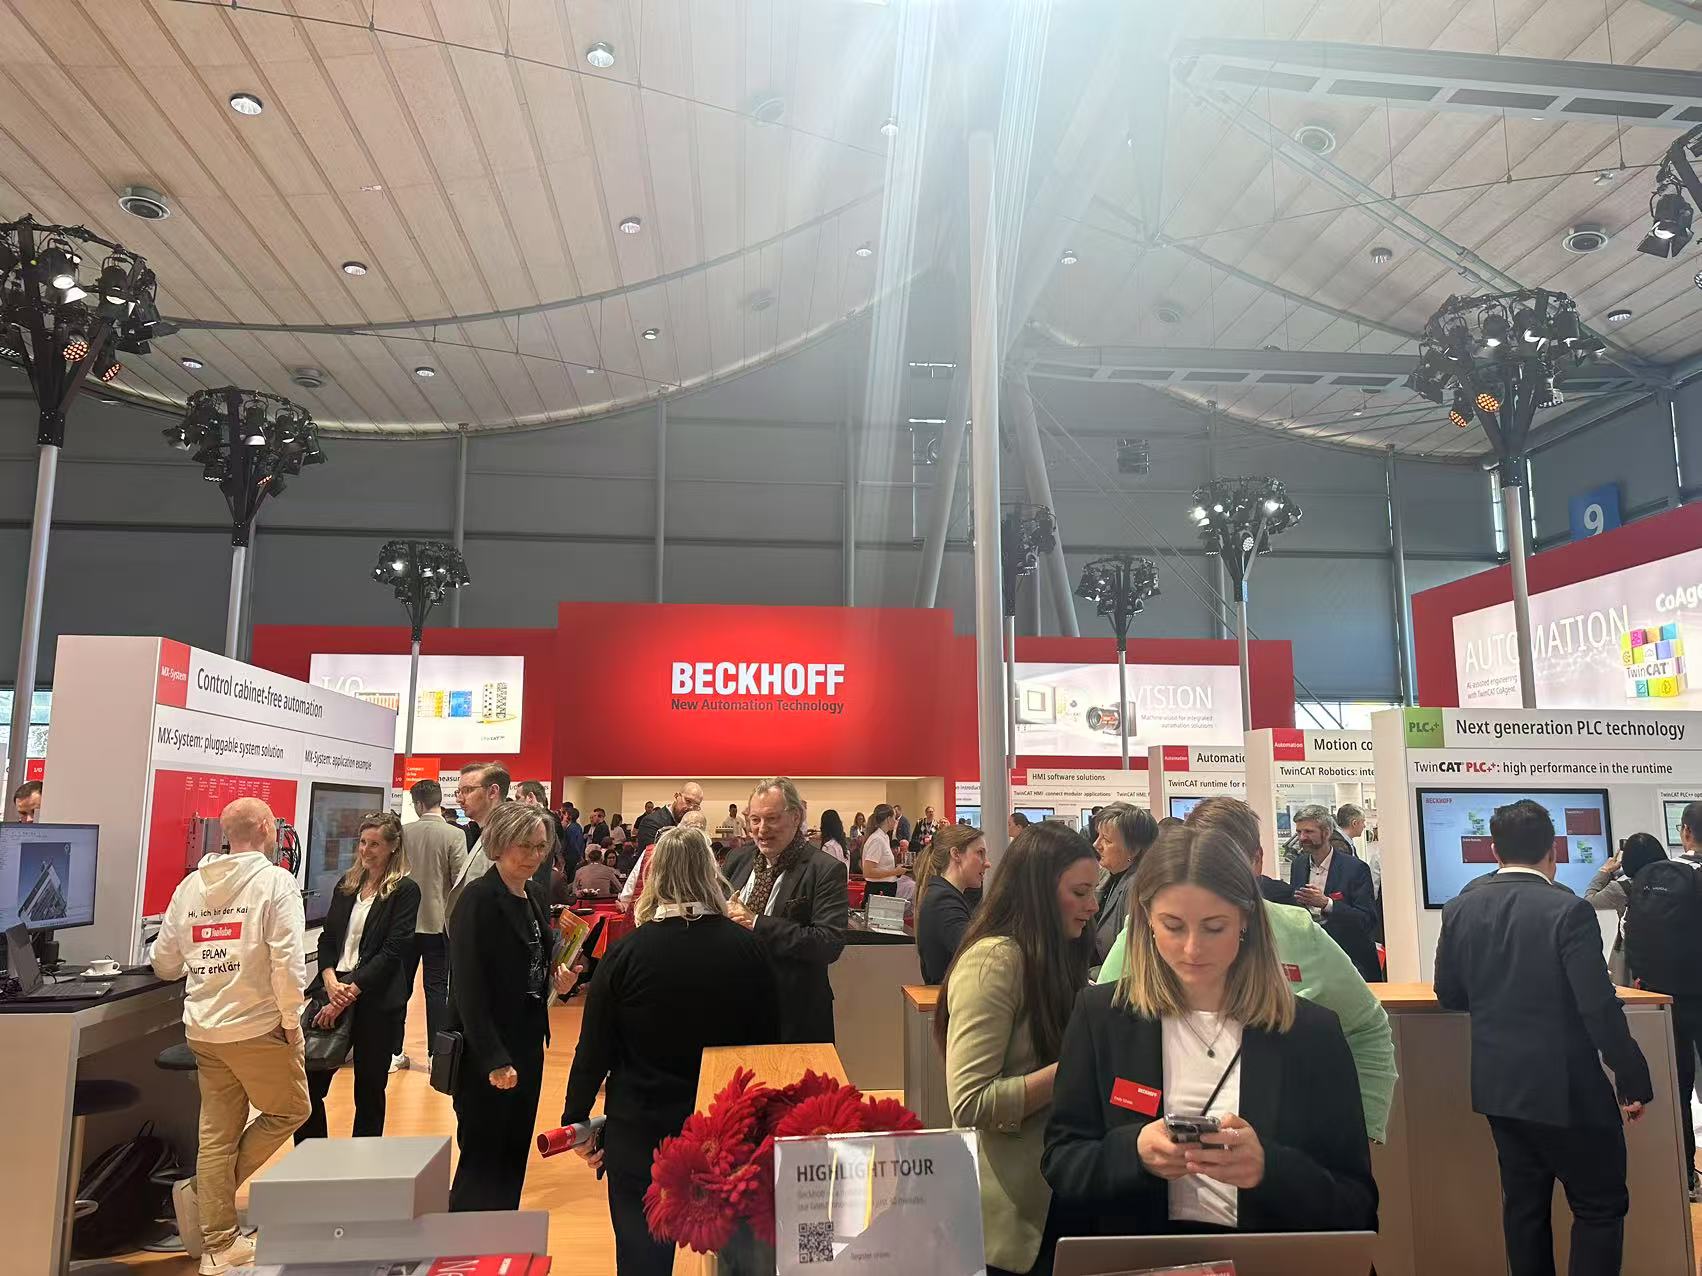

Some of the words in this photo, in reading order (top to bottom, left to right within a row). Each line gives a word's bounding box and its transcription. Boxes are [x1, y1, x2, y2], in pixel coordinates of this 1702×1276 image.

[1583, 503, 1604, 537] 9
[161, 665, 187, 681] MX-System
[1627, 661, 1668, 679] TwinCAT
[672, 661, 845, 696] BECKHOFF
[197, 667, 232, 697] Control
[234, 678, 283, 709] cabinet-free
[284, 694, 323, 718] automation
[1128, 685, 1213, 709] VISION
[672, 699, 698, 710] New
[701, 699, 773, 711] Automation
[777, 699, 844, 714] Technology
[1456, 719, 1490, 735] Next
[1494, 719, 1573, 739] generation
[1577, 720, 1602, 735] PLC
[1606, 720, 1685, 740] technology
[157, 726, 203, 751] MX-System:
[204, 734, 239, 755] pluggable
[239, 741, 261, 758] system
[261, 744, 284, 759] solution
[1314, 738, 1357, 751] Motion
[304, 749, 332, 767] MX-System:
[332, 754, 356, 769] application
[355, 758, 372, 771] example
[1280, 766, 1316, 776] TwinCAT
[1318, 766, 1358, 776] Robotics:
[1414, 761, 1462, 773] TwinCAT
[1503, 762, 1527, 776] high
[1530, 762, 1597, 776] performance
[1600, 763, 1610, 773] in
[1612, 763, 1629, 773] the
[1631, 763, 1673, 774] runtime
[1032, 773, 1046, 781] HMI
[1047, 773, 1075, 781] software
[1168, 780, 1198, 788] TwinCAT
[1200, 780, 1228, 788] runtime
[1229, 780, 1240, 788] for
[200, 909, 212, 917] ich
[236, 906, 249, 914] Kai
[201, 948, 227, 959] EPLAN
[208, 961, 241, 974] erklärt
[797, 1161, 892, 1182] HIGHLIGHT
[893, 1158, 934, 1177] TOUR
